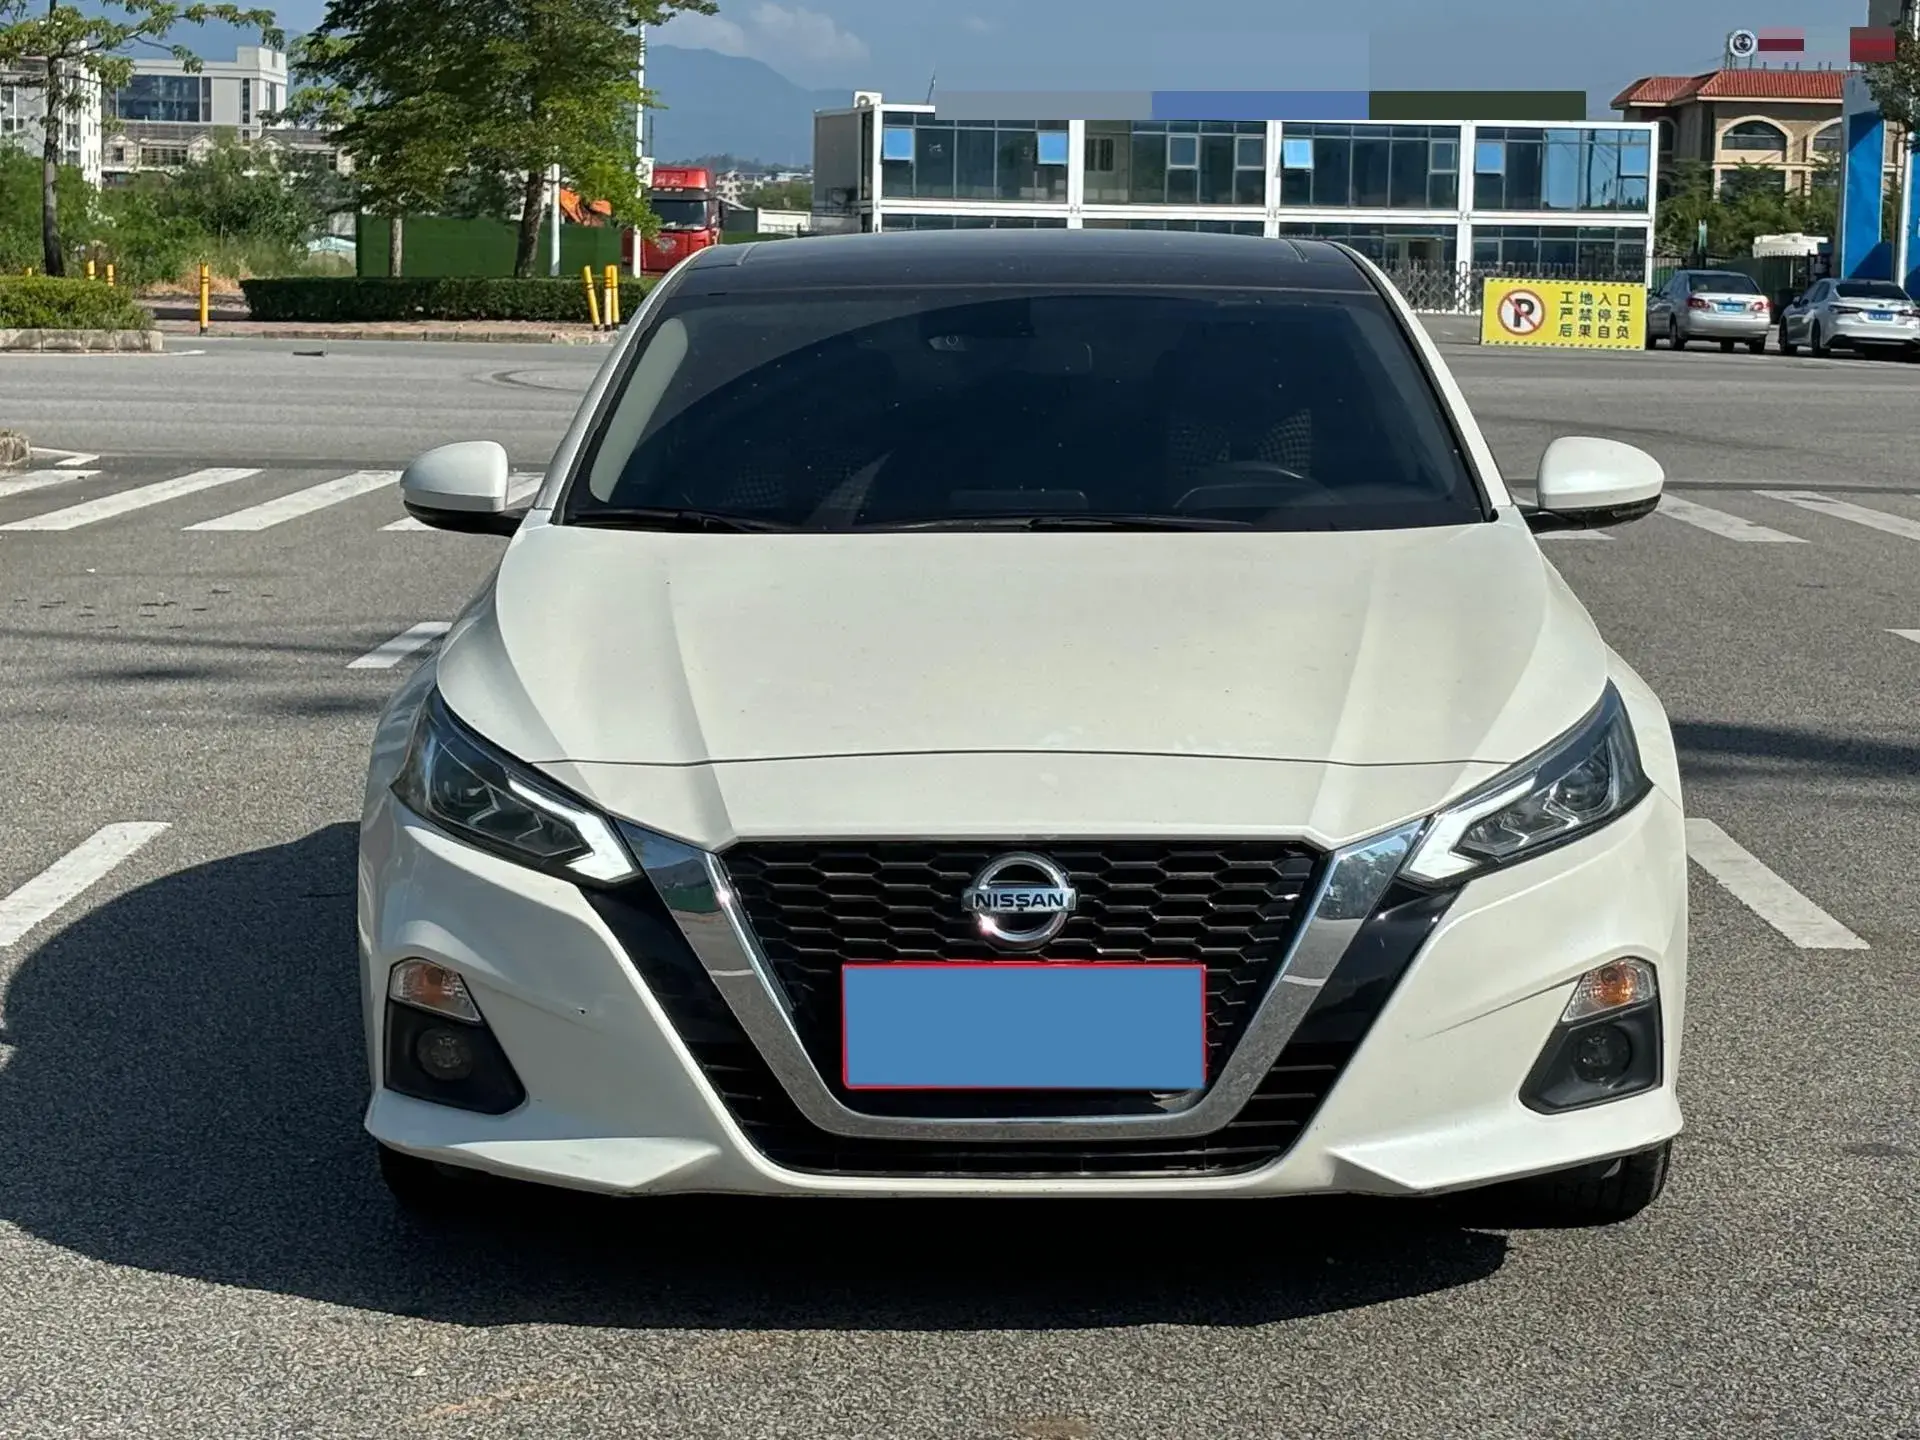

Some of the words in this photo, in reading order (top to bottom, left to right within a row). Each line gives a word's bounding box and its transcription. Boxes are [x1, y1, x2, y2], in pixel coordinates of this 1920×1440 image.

[1559, 291, 1631, 306] 工地入口
[1513, 298, 1535, 328] P
[1559, 307, 1631, 323] 严禁停车
[1558, 323, 1630, 340] 后果自负
[974, 893, 1064, 908] NISSAN
